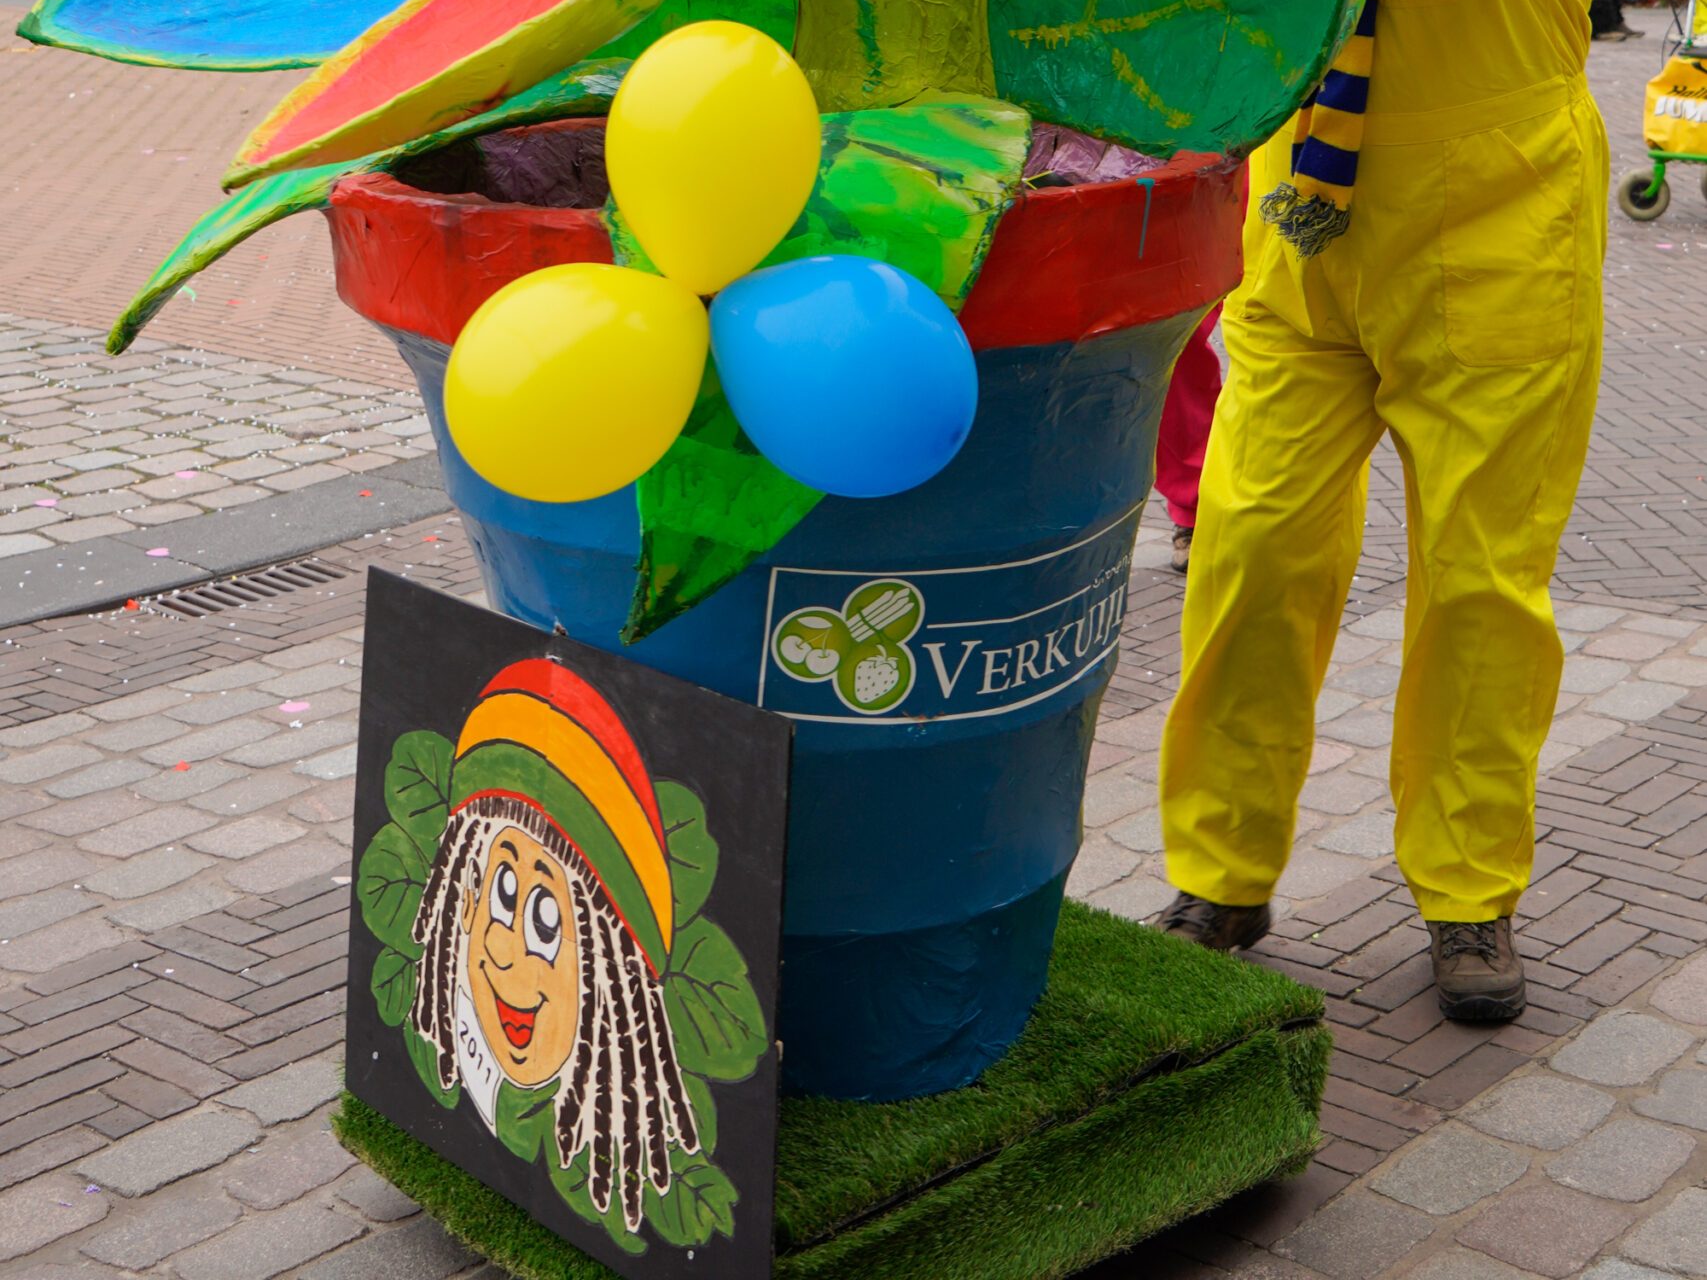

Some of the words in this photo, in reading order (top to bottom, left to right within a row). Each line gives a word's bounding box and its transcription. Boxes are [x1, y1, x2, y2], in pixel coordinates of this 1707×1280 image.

[1664, 84, 1707, 100] Hall
[922, 582, 1127, 700] VERKUIJL
[459, 1020, 491, 1084] 2011
